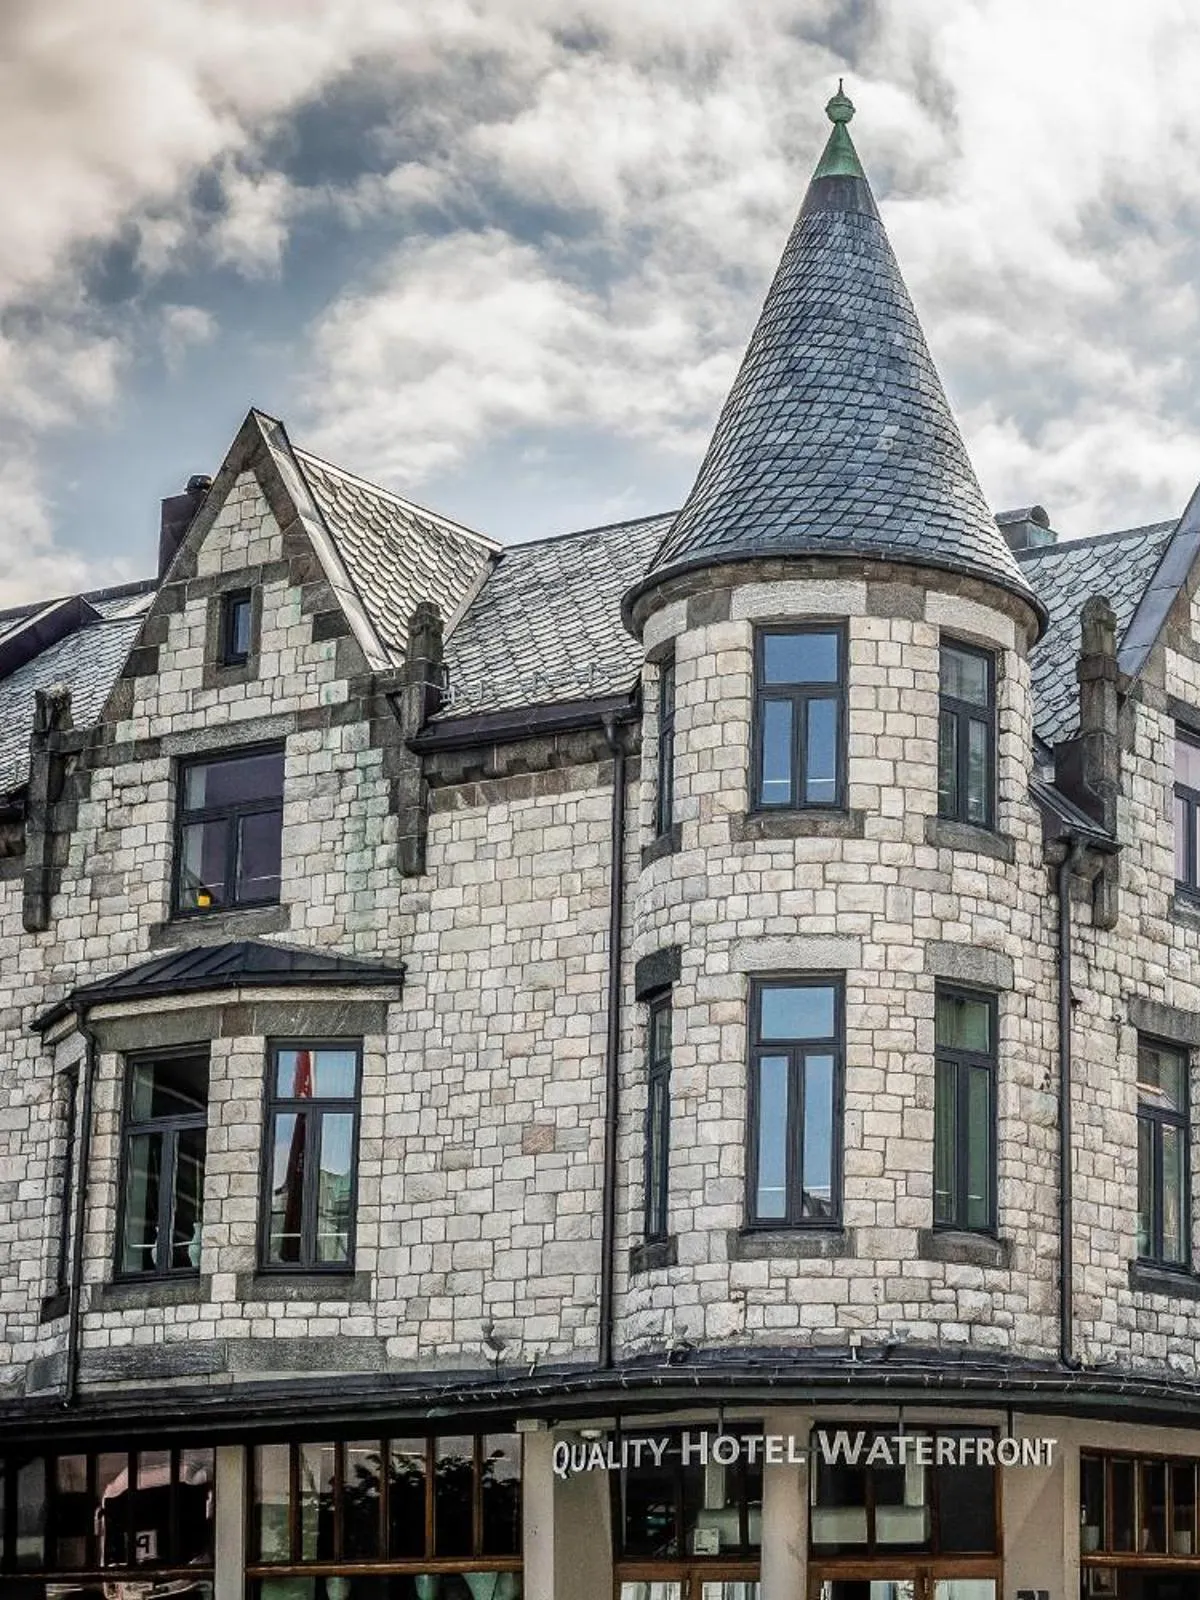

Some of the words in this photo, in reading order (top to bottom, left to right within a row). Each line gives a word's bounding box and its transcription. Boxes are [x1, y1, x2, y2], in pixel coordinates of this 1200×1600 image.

[552, 1438, 669, 1479] QUALITY
[681, 1431, 805, 1465] HOTEL
[817, 1430, 1057, 1465] WATERFRONT
